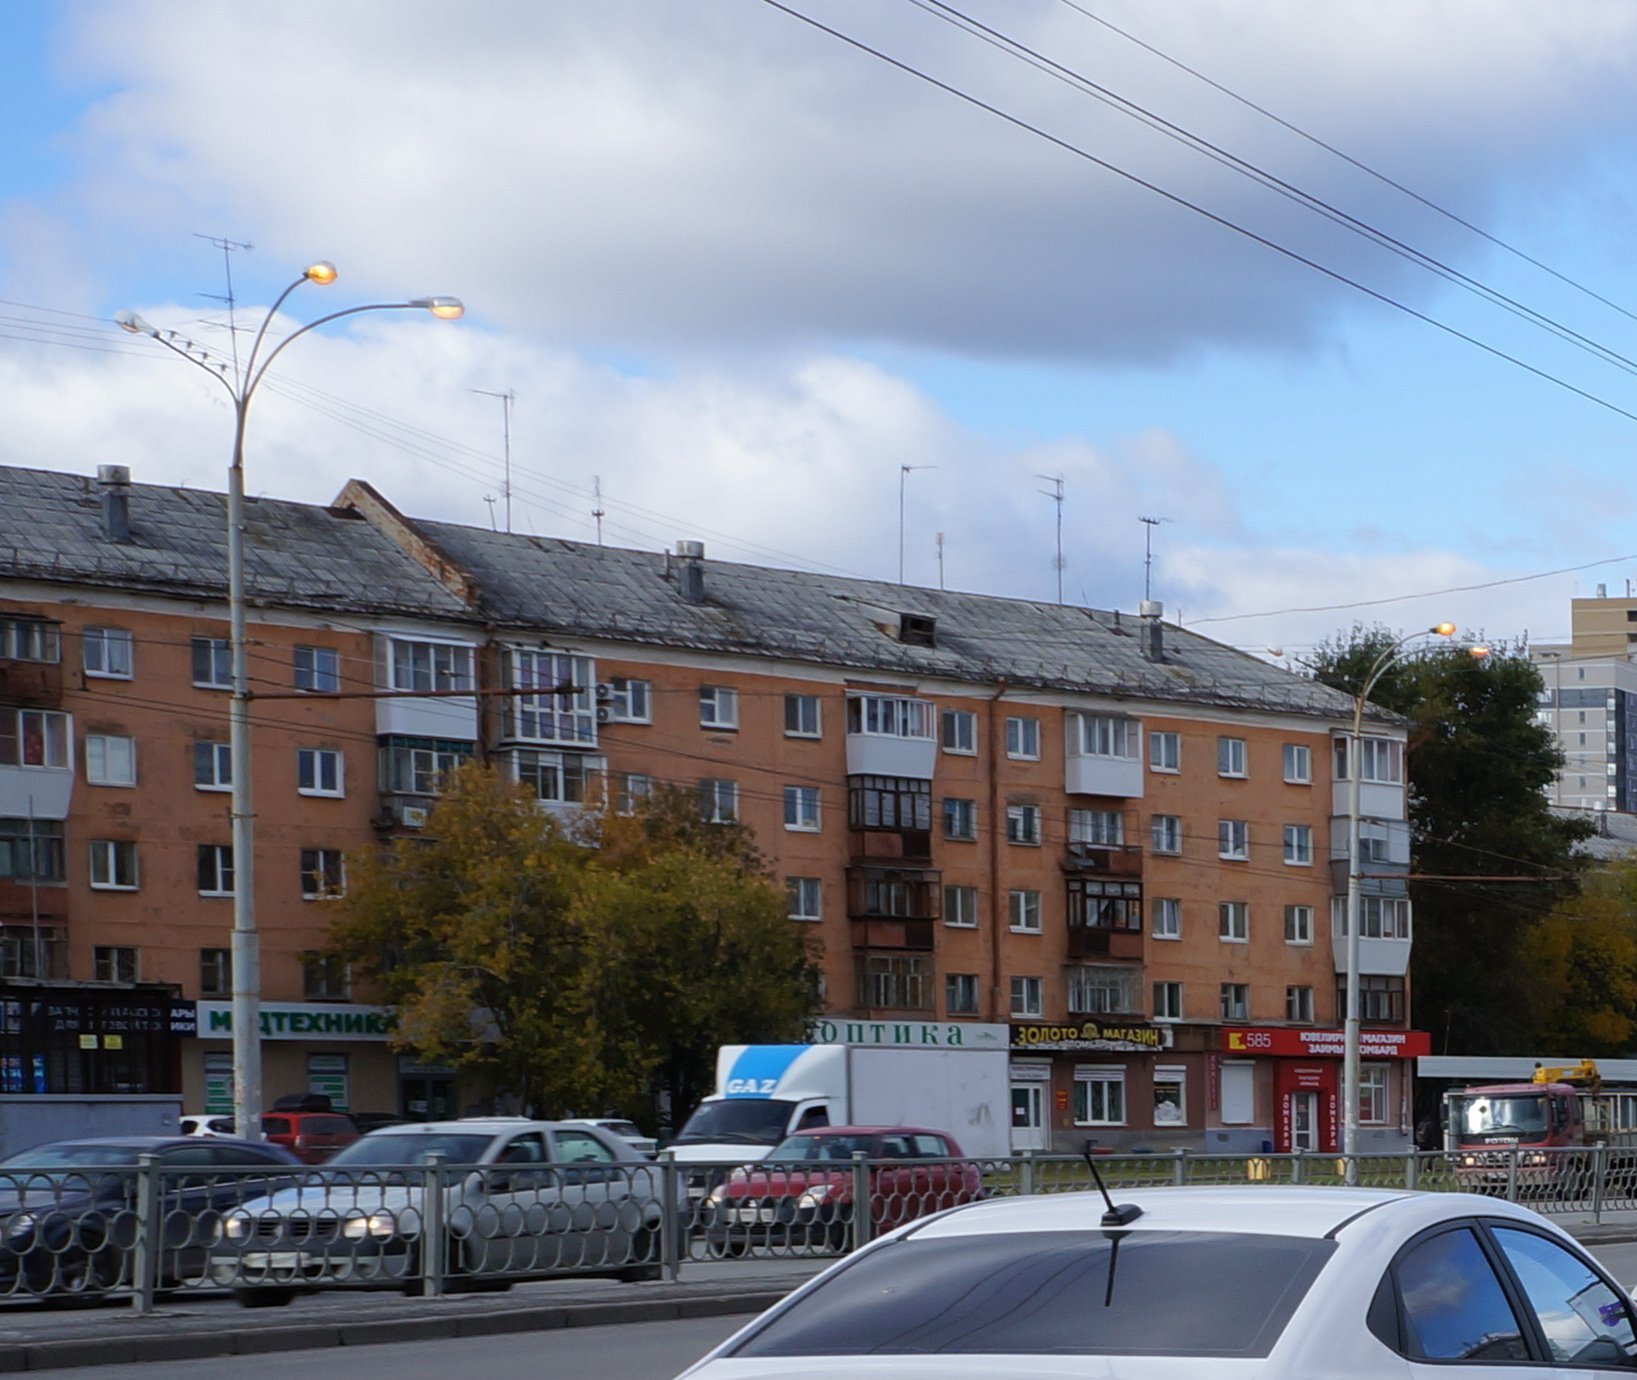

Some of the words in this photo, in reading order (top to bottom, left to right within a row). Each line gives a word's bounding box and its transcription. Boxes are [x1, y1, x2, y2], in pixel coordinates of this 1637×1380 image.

[209, 1010, 399, 1035] МДТЕХНИКА
[1017, 1026, 1079, 1046] ЗОЛОТО
[1101, 1027, 1159, 1046] МАГАЗИН
[1246, 1032, 1272, 1048] 585
[1355, 1044, 1398, 1055] ОМБАРД
[727, 1078, 778, 1094] GAZ
